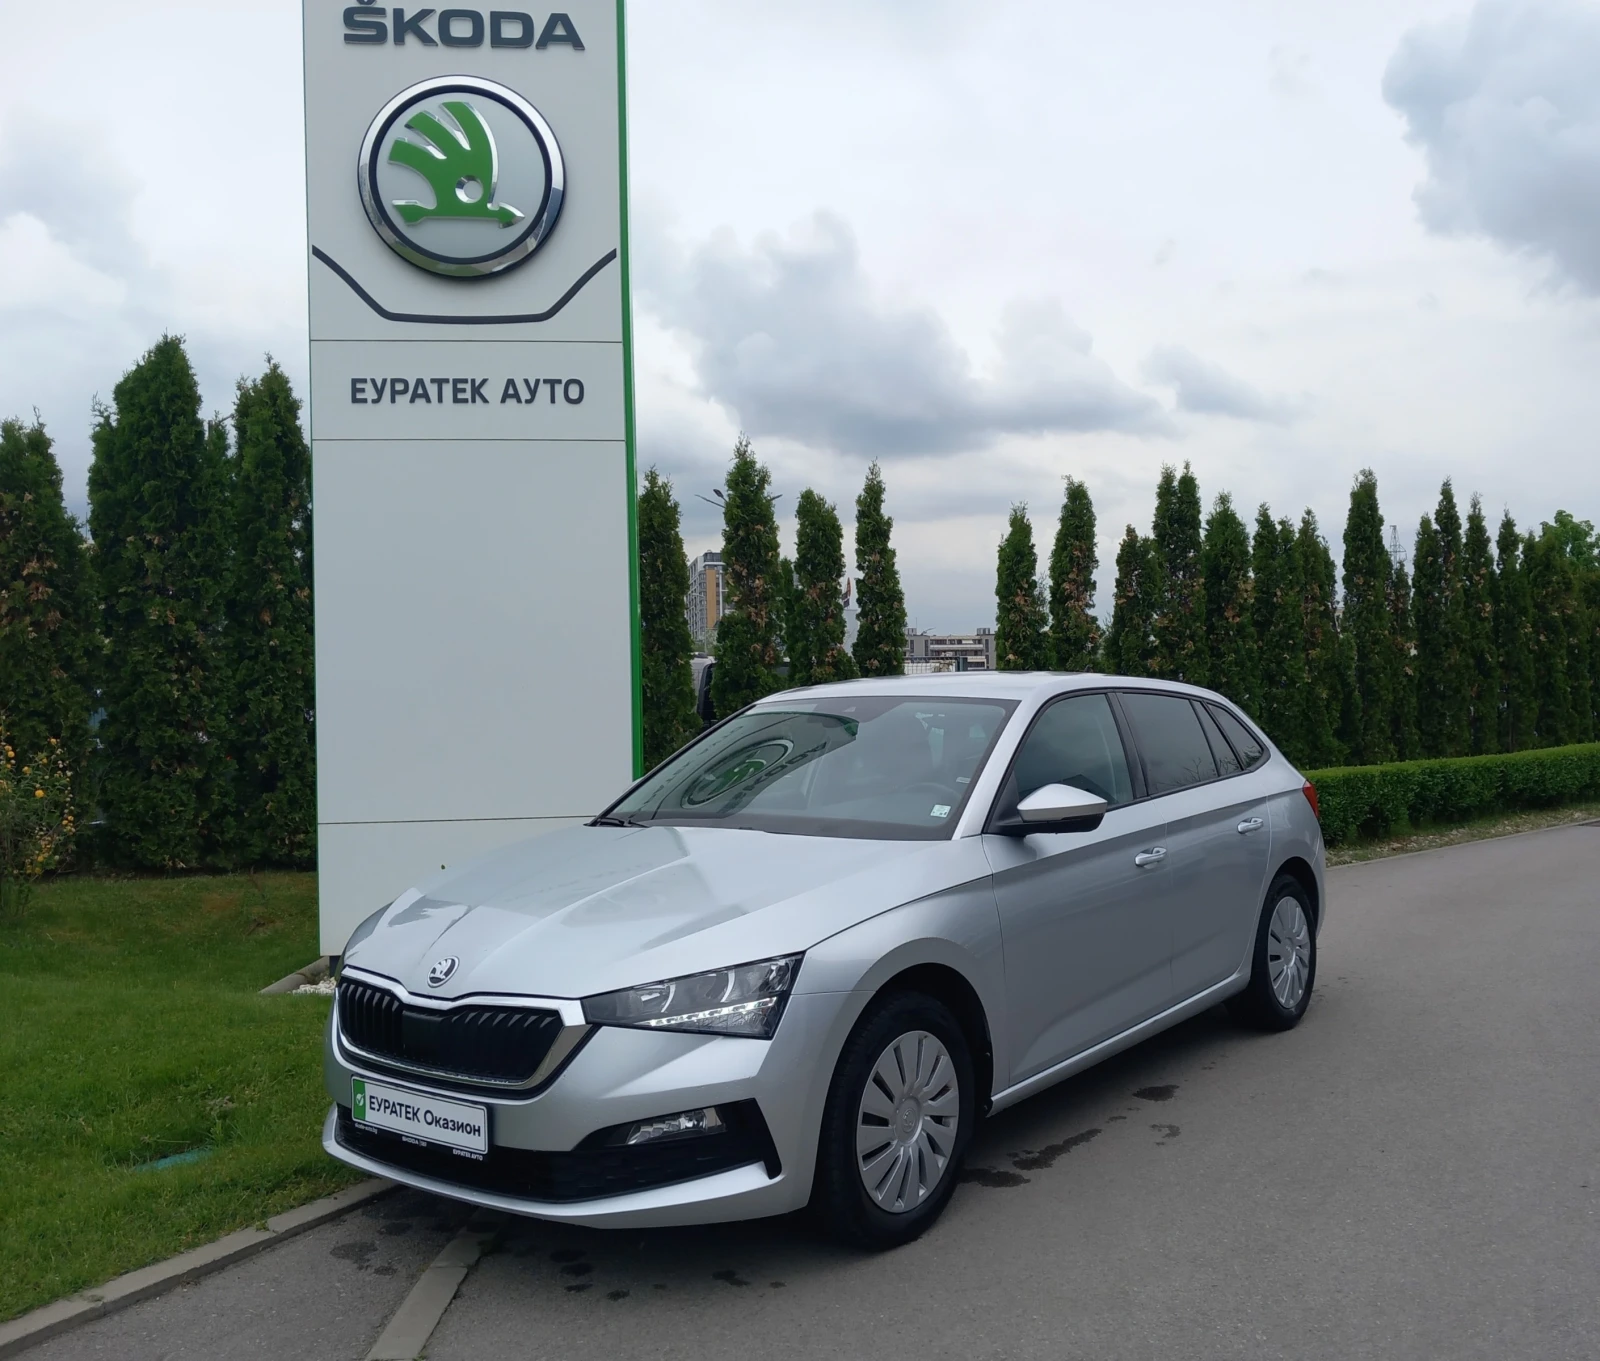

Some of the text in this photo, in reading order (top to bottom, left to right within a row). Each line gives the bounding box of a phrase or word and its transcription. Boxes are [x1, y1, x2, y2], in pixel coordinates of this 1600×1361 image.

[343, 0, 586, 50] ŠKODA
[350, 378, 585, 404] ЕУРАТЕК АУТО
[369, 1095, 481, 1137] ЕУРАТЕК Оказион
